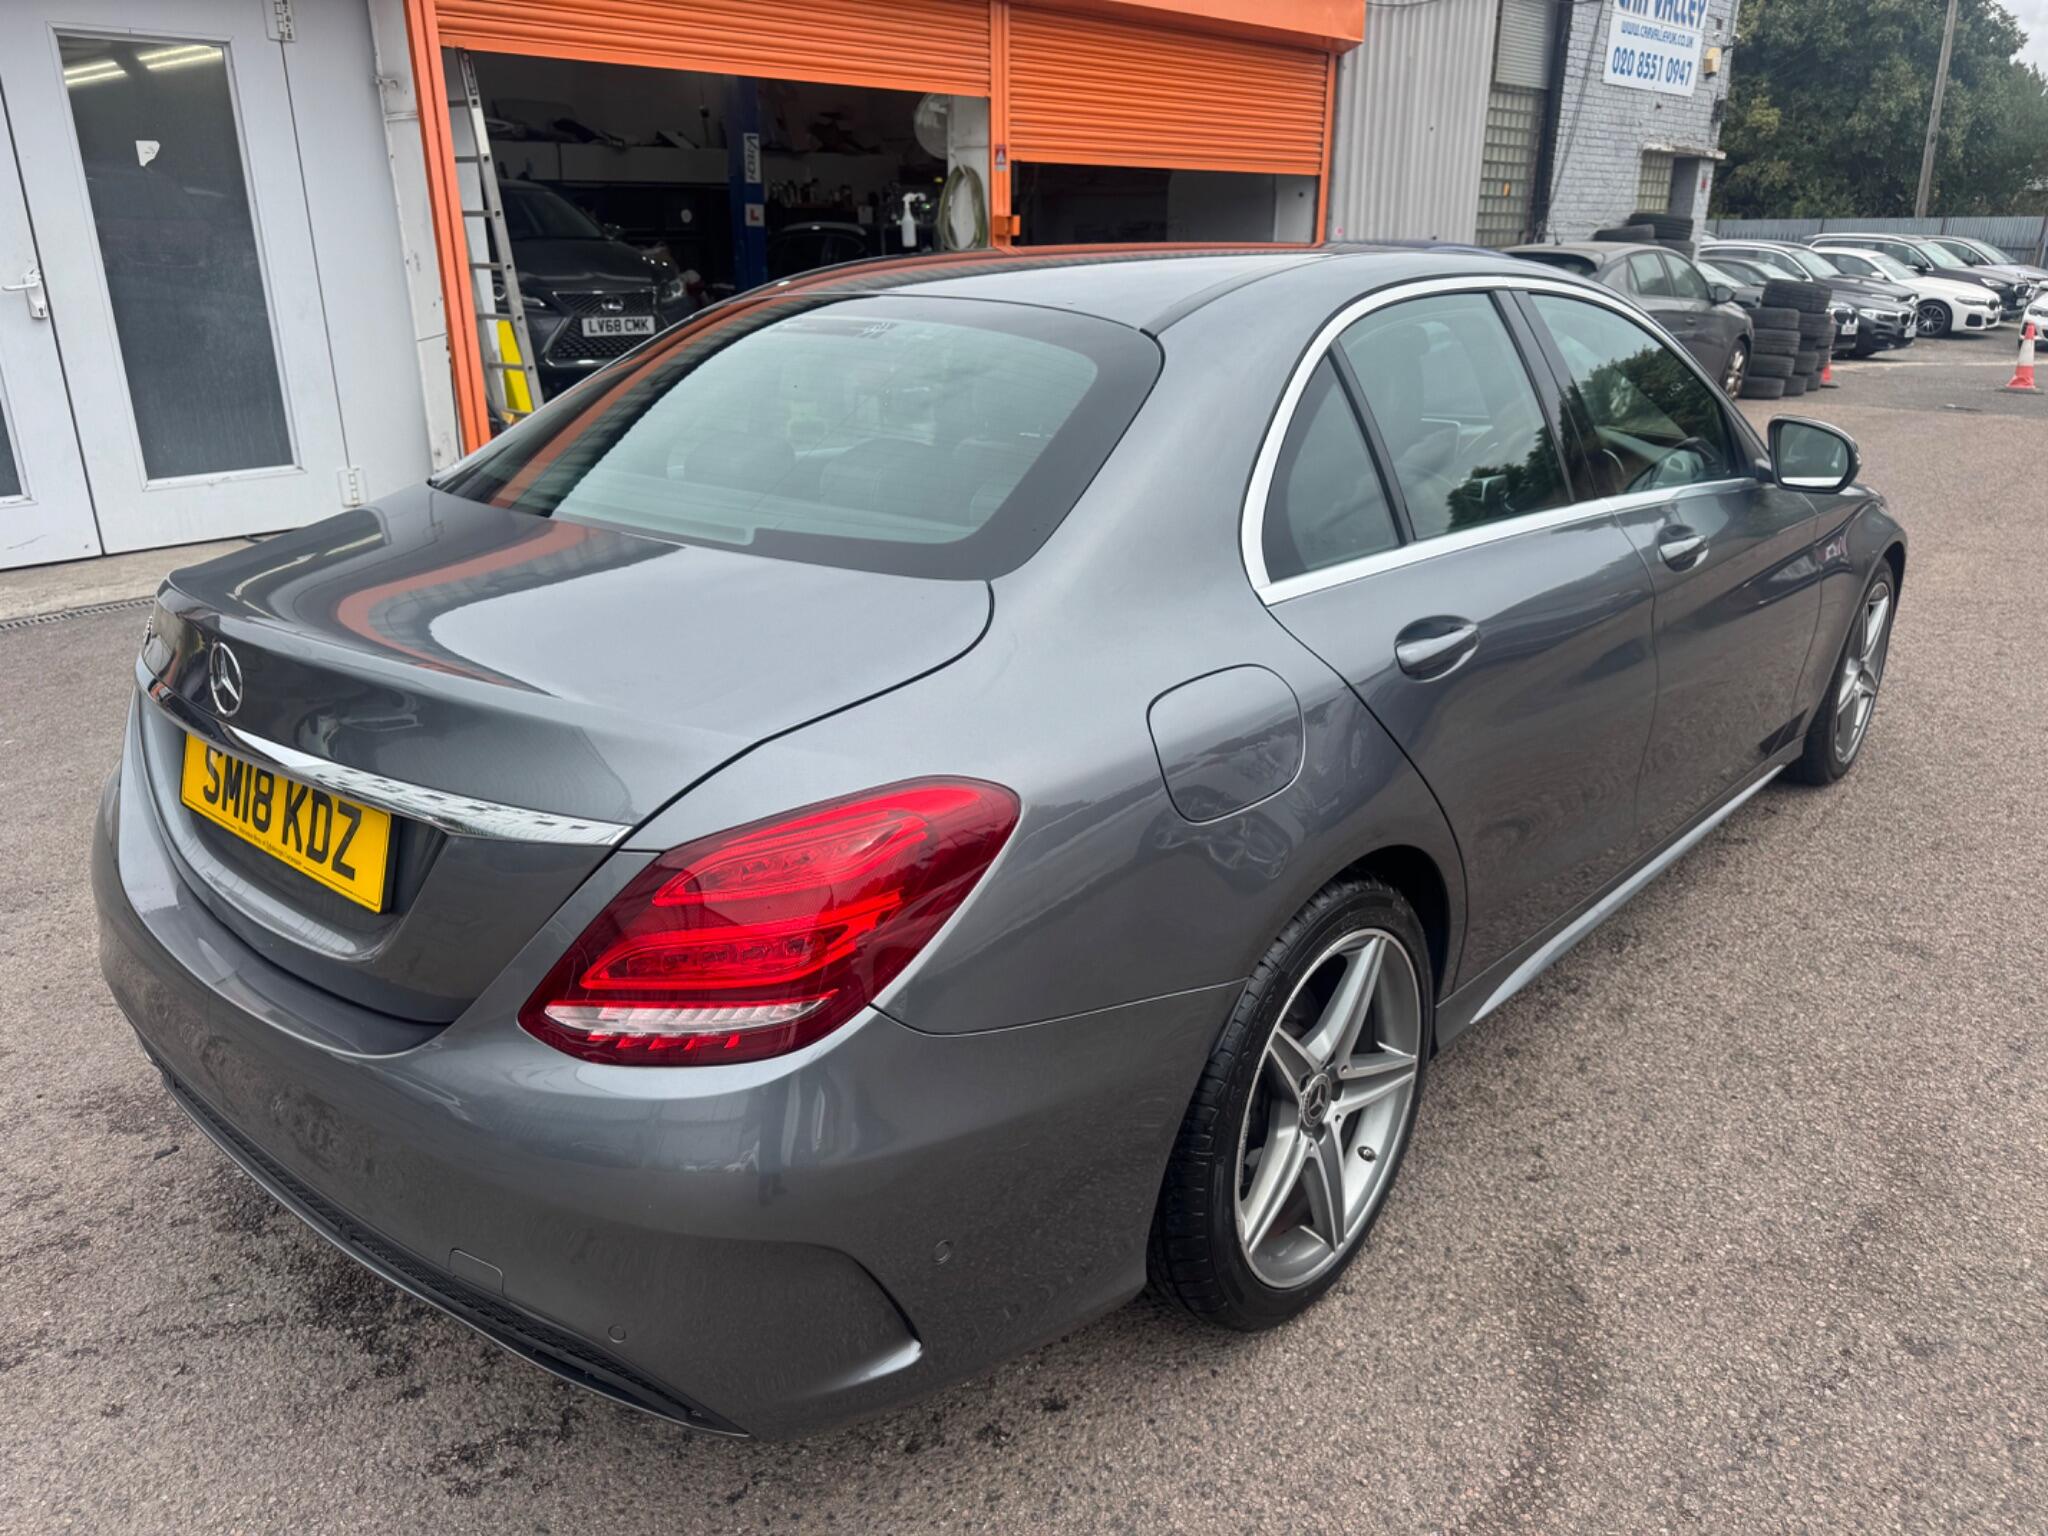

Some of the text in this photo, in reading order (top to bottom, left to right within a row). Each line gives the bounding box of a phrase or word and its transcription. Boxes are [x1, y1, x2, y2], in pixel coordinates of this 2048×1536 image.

[1654, 0, 1707, 29] VALLEY
[1612, 46, 1692, 87] 020 8551 0947
[588, 317, 650, 334] LV68 CMK
[202, 744, 275, 834] SM18
[281, 779, 362, 881] KDZ
